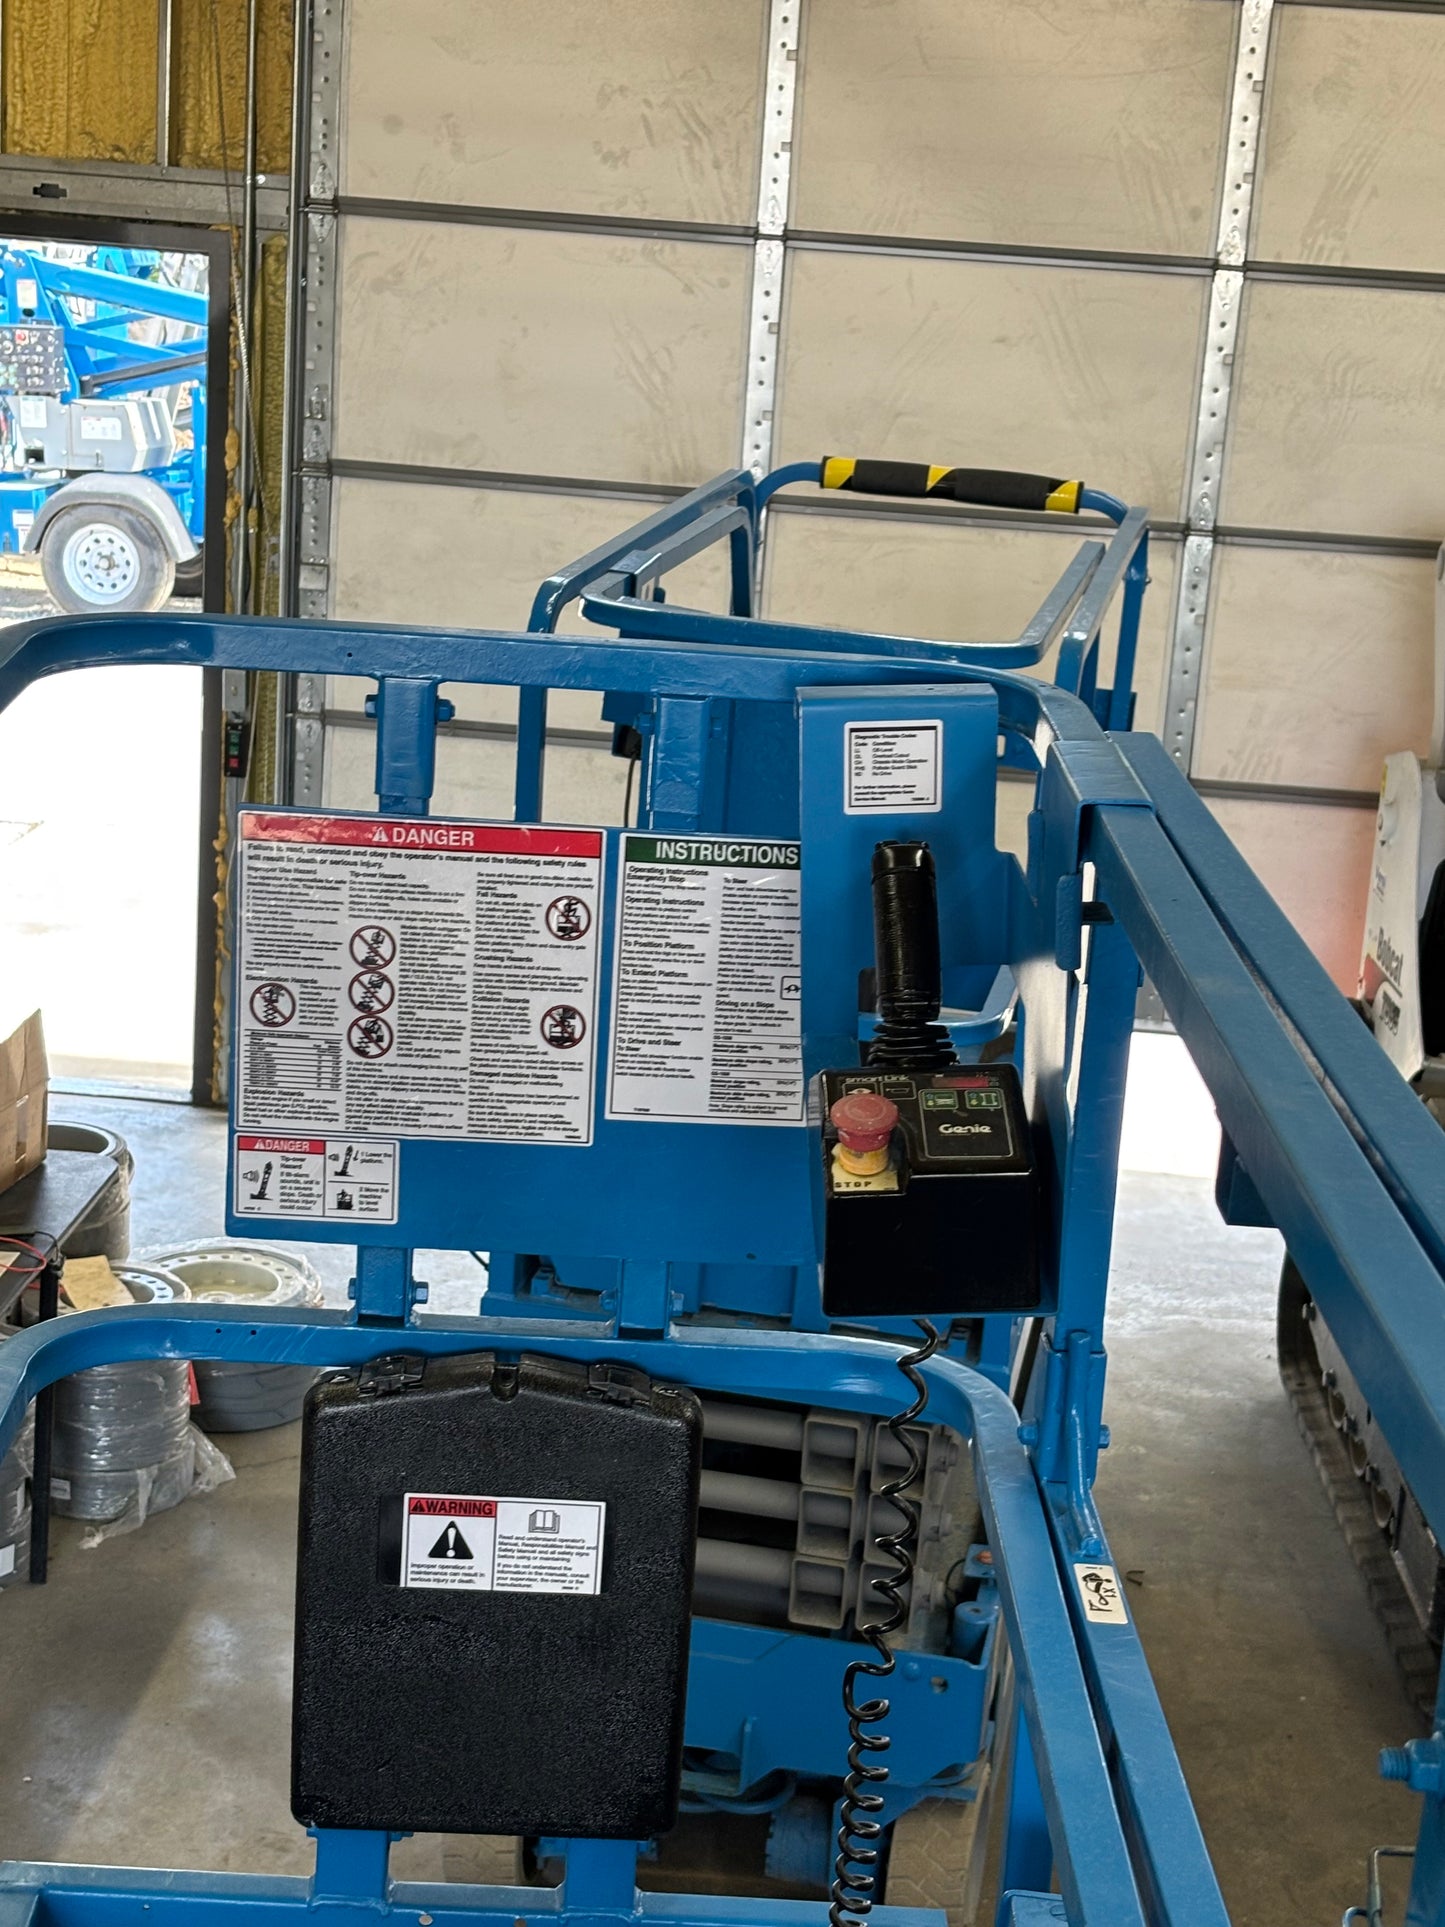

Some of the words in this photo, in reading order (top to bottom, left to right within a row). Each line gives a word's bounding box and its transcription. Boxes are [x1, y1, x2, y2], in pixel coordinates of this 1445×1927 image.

[392, 828, 475, 847] DANGER
[655, 841, 799, 865] INSTRUCTIONS
[629, 865, 664, 875] Operating
[665, 867, 708, 876] Instructions
[627, 873, 666, 882] Emergency
[667, 874, 685, 883] Stop
[625, 895, 660, 905] Operating
[661, 897, 705, 905] Instructions
[938, 1124, 992, 1134] Genie
[264, 1140, 310, 1152] DANGER
[426, 1500, 493, 1515] WARNING
